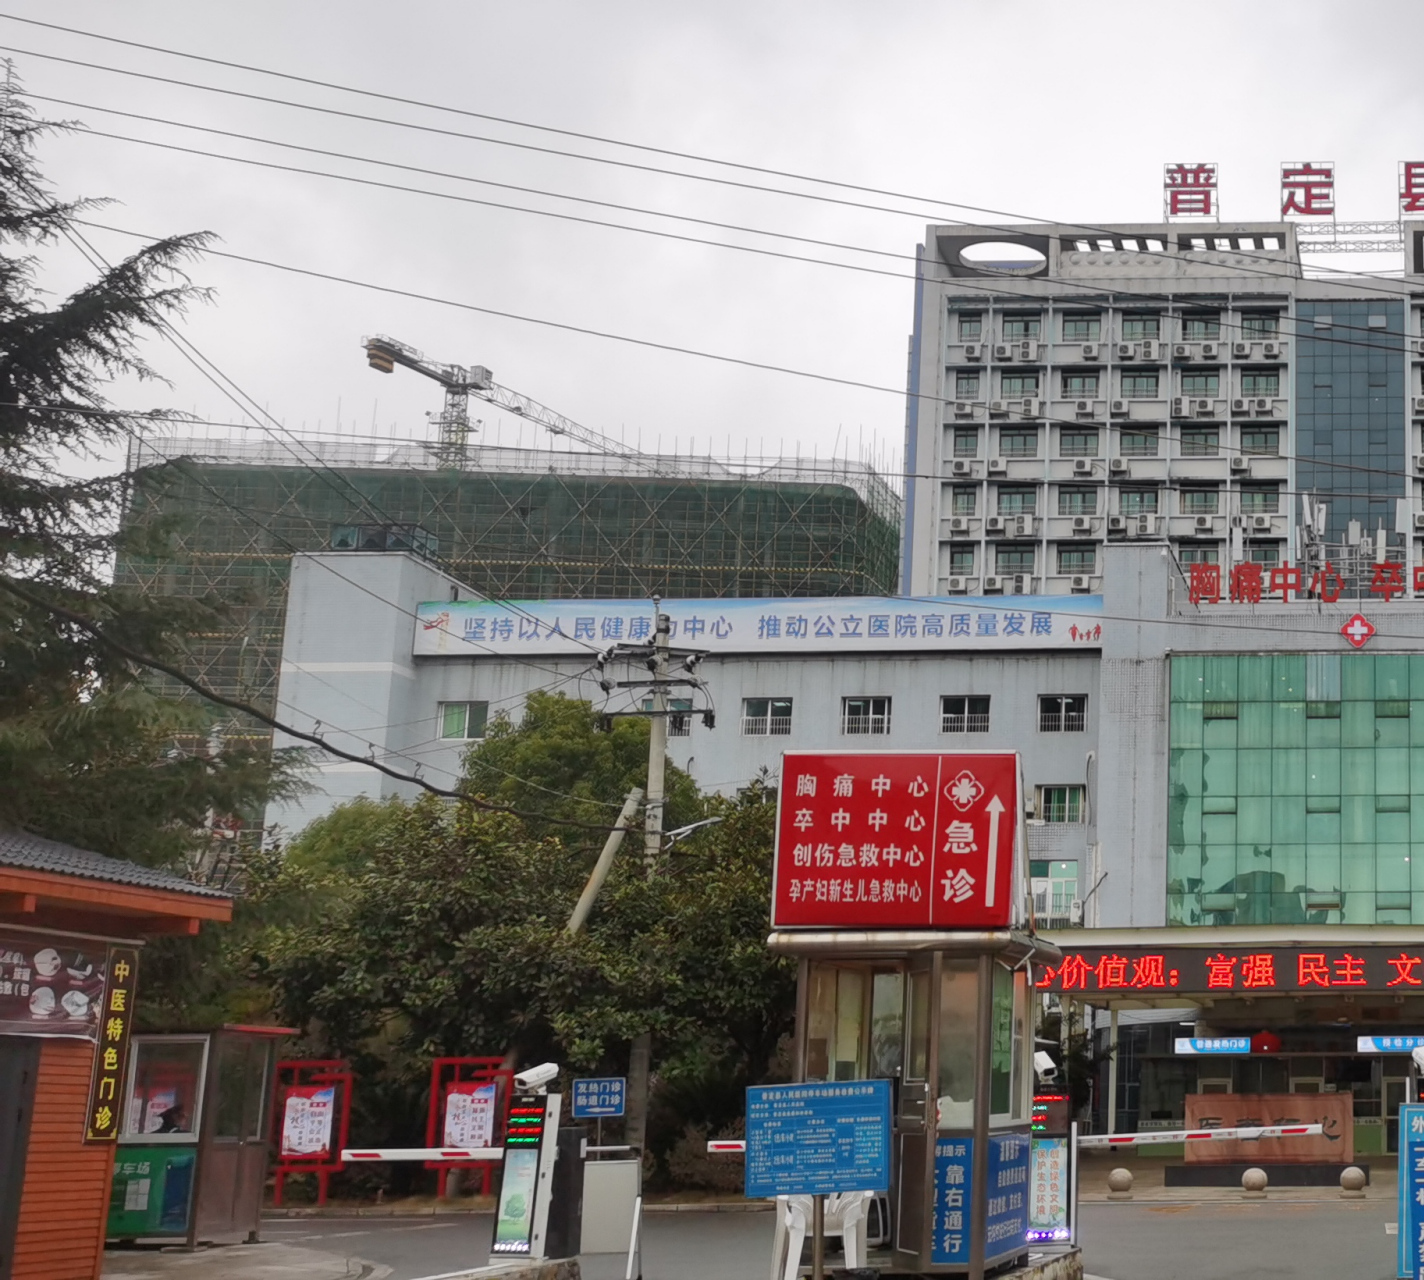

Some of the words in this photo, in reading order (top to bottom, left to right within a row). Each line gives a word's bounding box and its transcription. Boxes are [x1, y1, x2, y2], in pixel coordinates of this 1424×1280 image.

[1188, 561, 1345, 604] 胸痛中心
[757, 613, 1053, 639] 推动公立医院高质量发展
[796, 774, 929, 798] 胸痛中心
[793, 808, 926, 832] 卒中中心
[793, 843, 925, 867] 创伤急救中心
[940, 820, 977, 904] 急诊
[789, 878, 922, 903] 孕产妇新生儿急救中心
[1205, 953, 1275, 988] 富强
[1297, 952, 1367, 987] 民主
[95, 960, 130, 1130] 中医特色门诊
[577, 1082, 621, 1094] 发热门诊
[577, 1094, 621, 1106] 肠道门诊
[943, 1164, 964, 1254] 靠右通行
